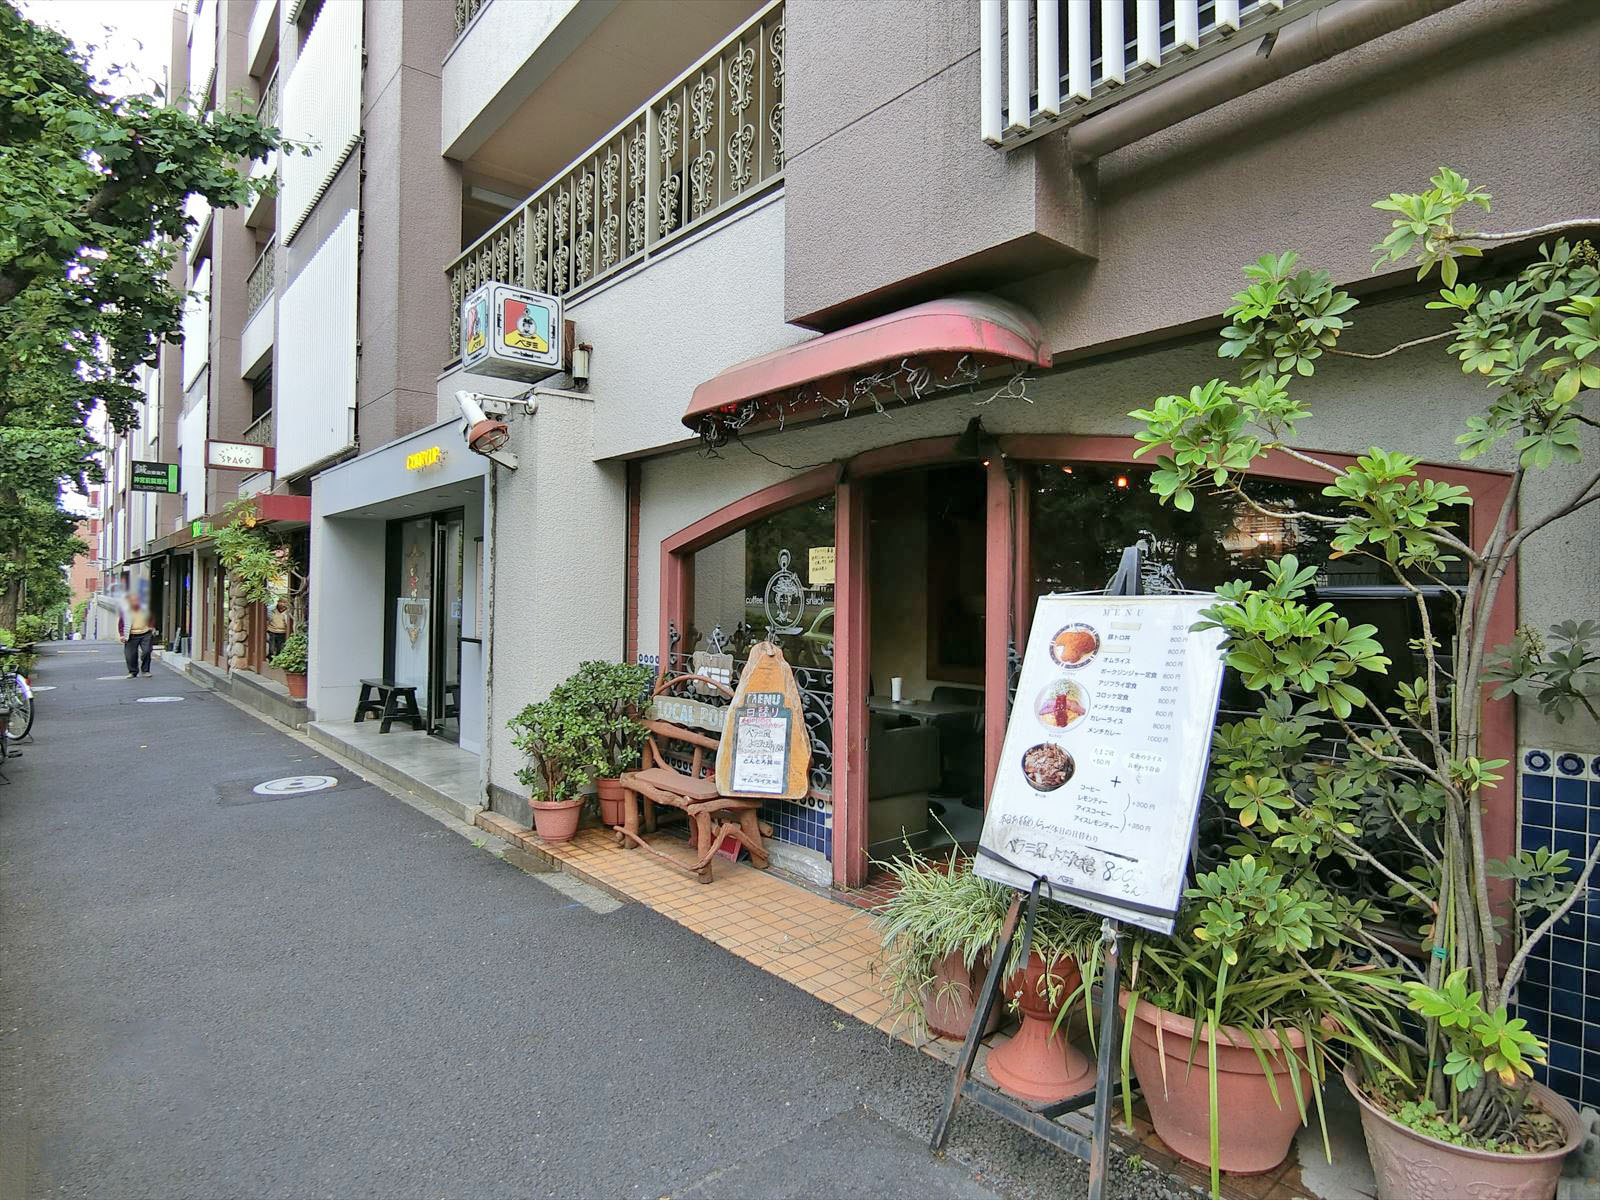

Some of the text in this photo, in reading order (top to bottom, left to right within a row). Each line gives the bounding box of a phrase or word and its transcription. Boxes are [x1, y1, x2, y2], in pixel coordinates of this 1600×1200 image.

[221, 455, 251, 464] SPAGO
[745, 595, 825, 606] coffee snack
[1102, 608, 1145, 617] MENU
[1103, 657, 1131, 665] オムライス
[1098, 679, 1137, 690] アジフライ定食
[1096, 691, 1129, 701] コロッケ定食
[657, 701, 694, 725] LOCAL
[746, 705, 779, 717] 日替り
[1092, 703, 1133, 714] メンチカツ定食
[1089, 715, 1124, 725] カレーライス
[1087, 727, 1122, 737] メンチカレー
[1079, 783, 1102, 793] コーヒー
[1077, 793, 1109, 805] レモンティー
[1075, 804, 1112, 817] アイスコーヒー
[1073, 814, 1119, 831] アイスレモンティー
